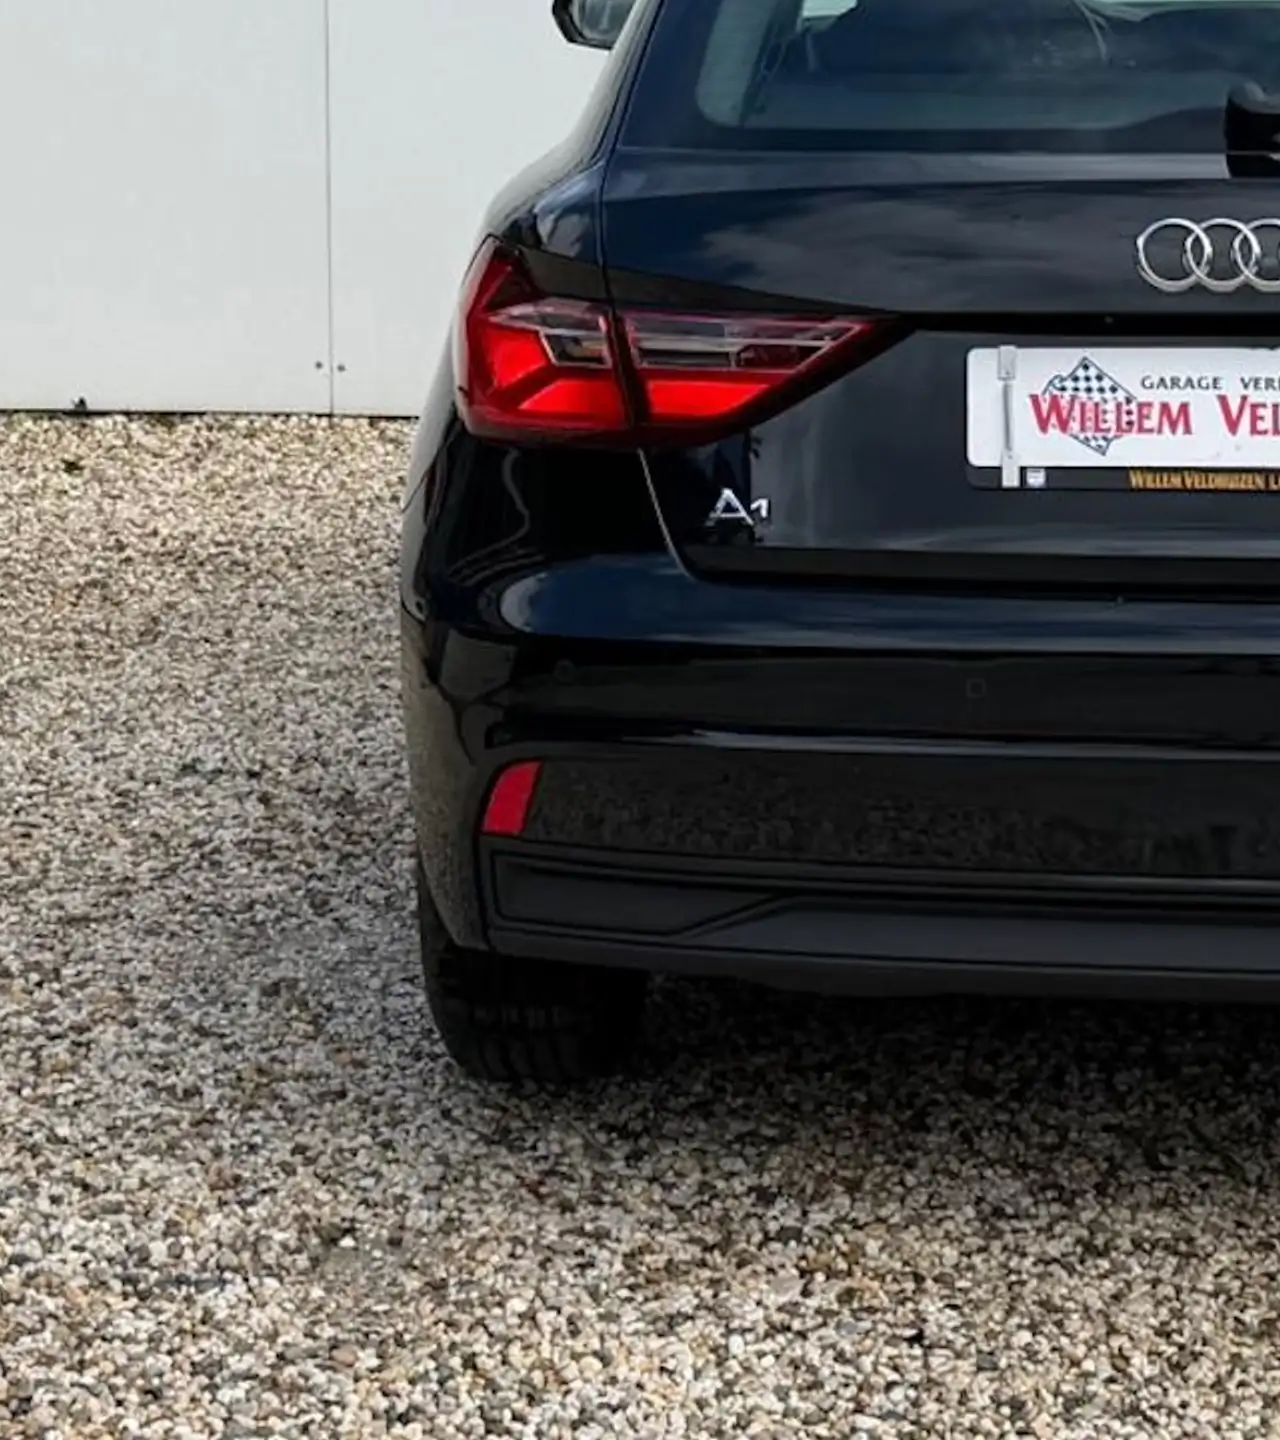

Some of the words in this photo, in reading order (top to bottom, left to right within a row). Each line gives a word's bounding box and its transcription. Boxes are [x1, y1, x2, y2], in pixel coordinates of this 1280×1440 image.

[1140, 375, 1223, 391] GARAGE
[1029, 393, 1192, 436] WILLEM
[1129, 469, 1182, 489] WILLEM
[705, 488, 768, 527] A1
